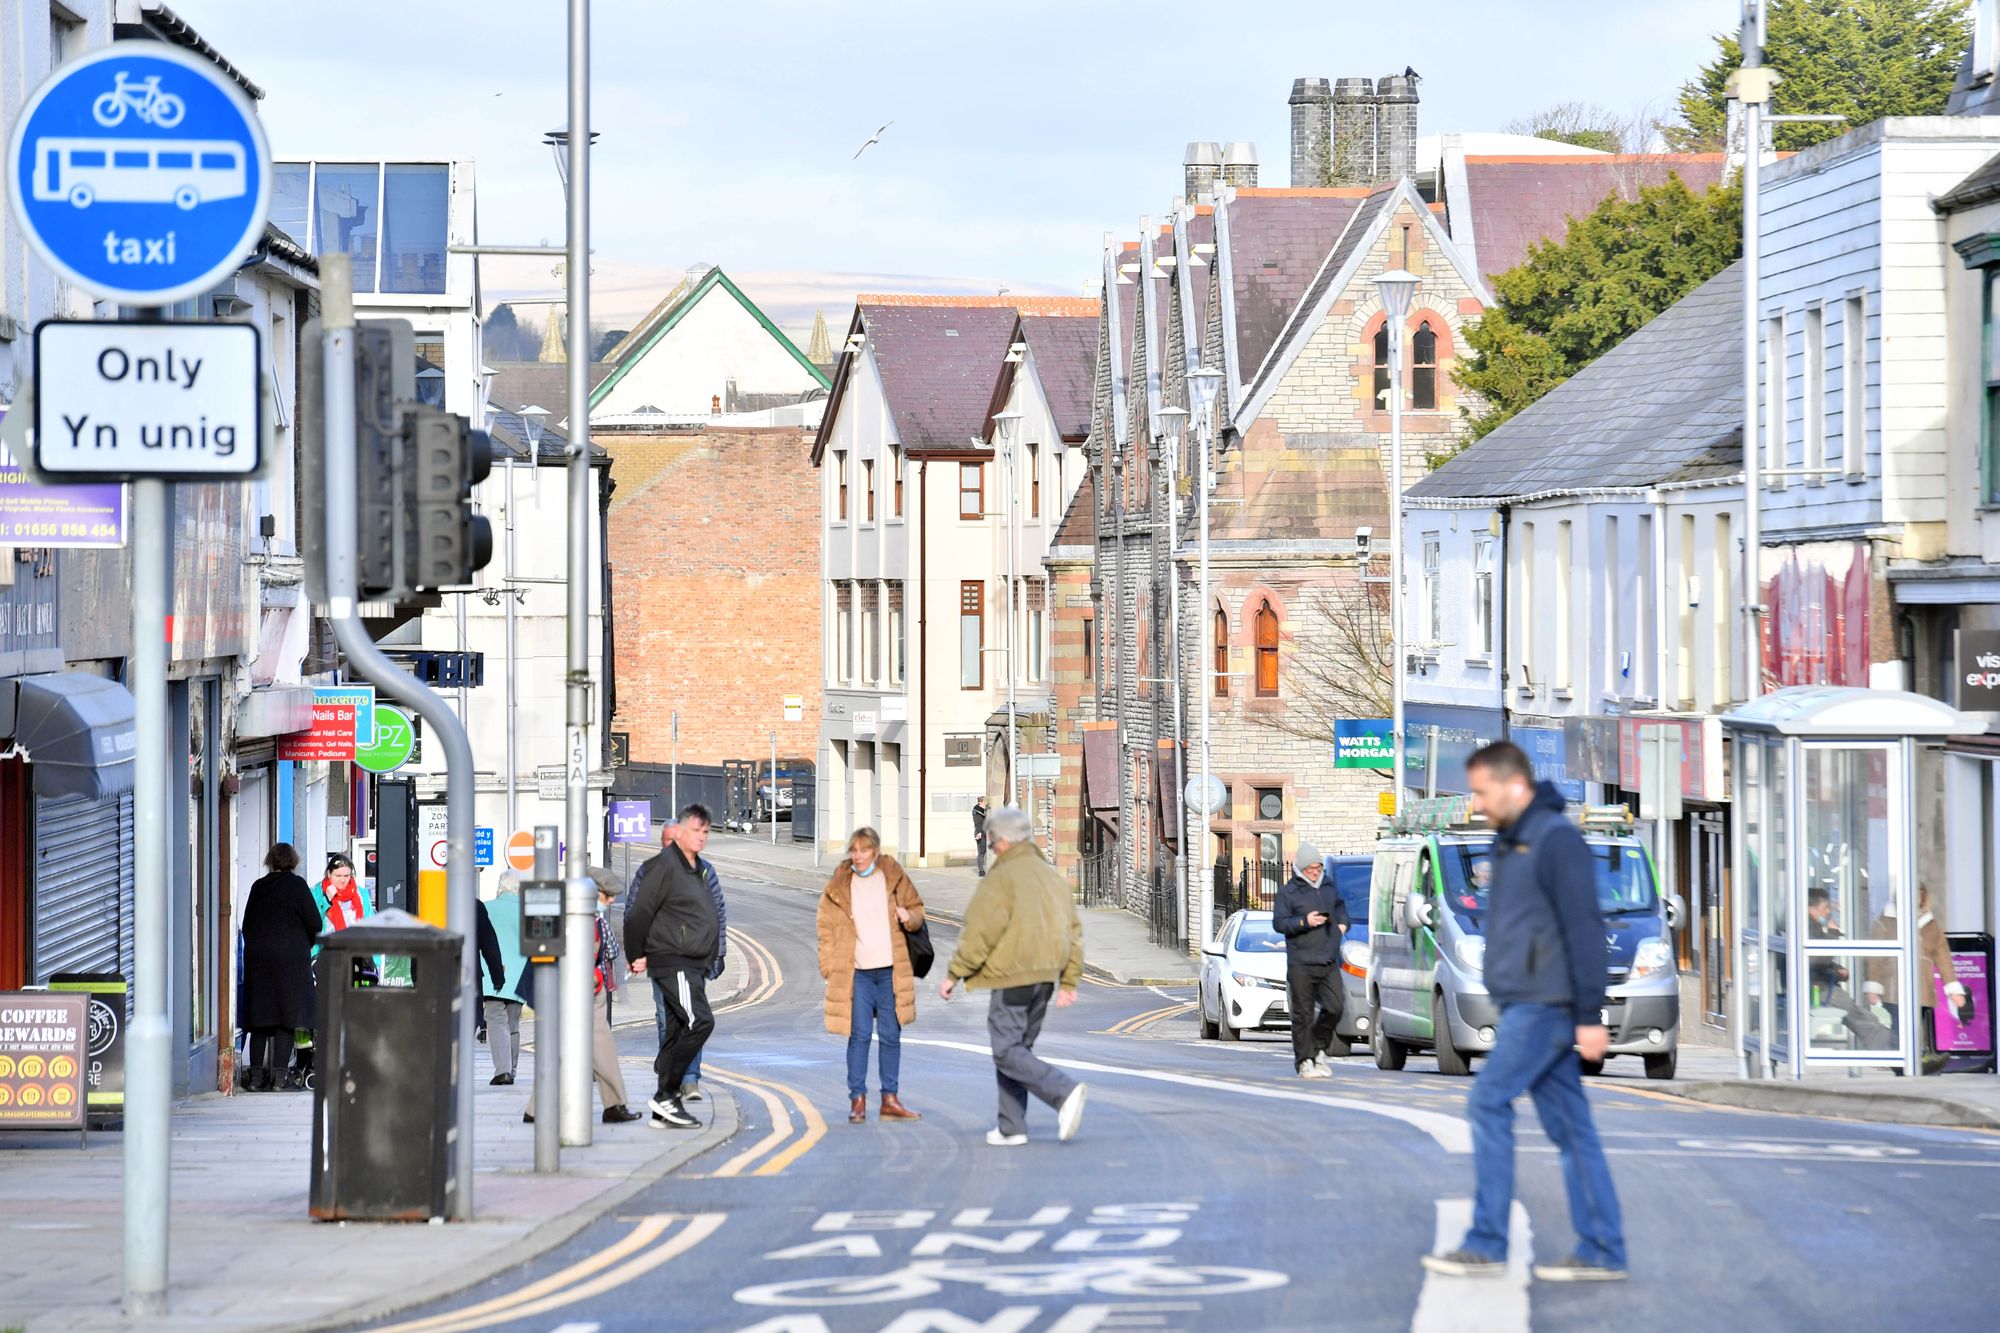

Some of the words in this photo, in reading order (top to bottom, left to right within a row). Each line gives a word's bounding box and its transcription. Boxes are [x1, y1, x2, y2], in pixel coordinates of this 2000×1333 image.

[104, 230, 175, 264] taxi
[98, 347, 203, 388] Only
[63, 416, 118, 448] Yn
[141, 416, 236, 456] unig
[1975, 651, 2000, 668] vis
[313, 710, 334, 721] Nails
[338, 710, 354, 721] Bar
[1339, 736, 1381, 746] WATTS
[613, 813, 646, 833] hrt
[1, 1009, 67, 1024] COFFEE
[811, 1202, 1200, 1231] BUS
[763, 1229, 1183, 1260] AND
